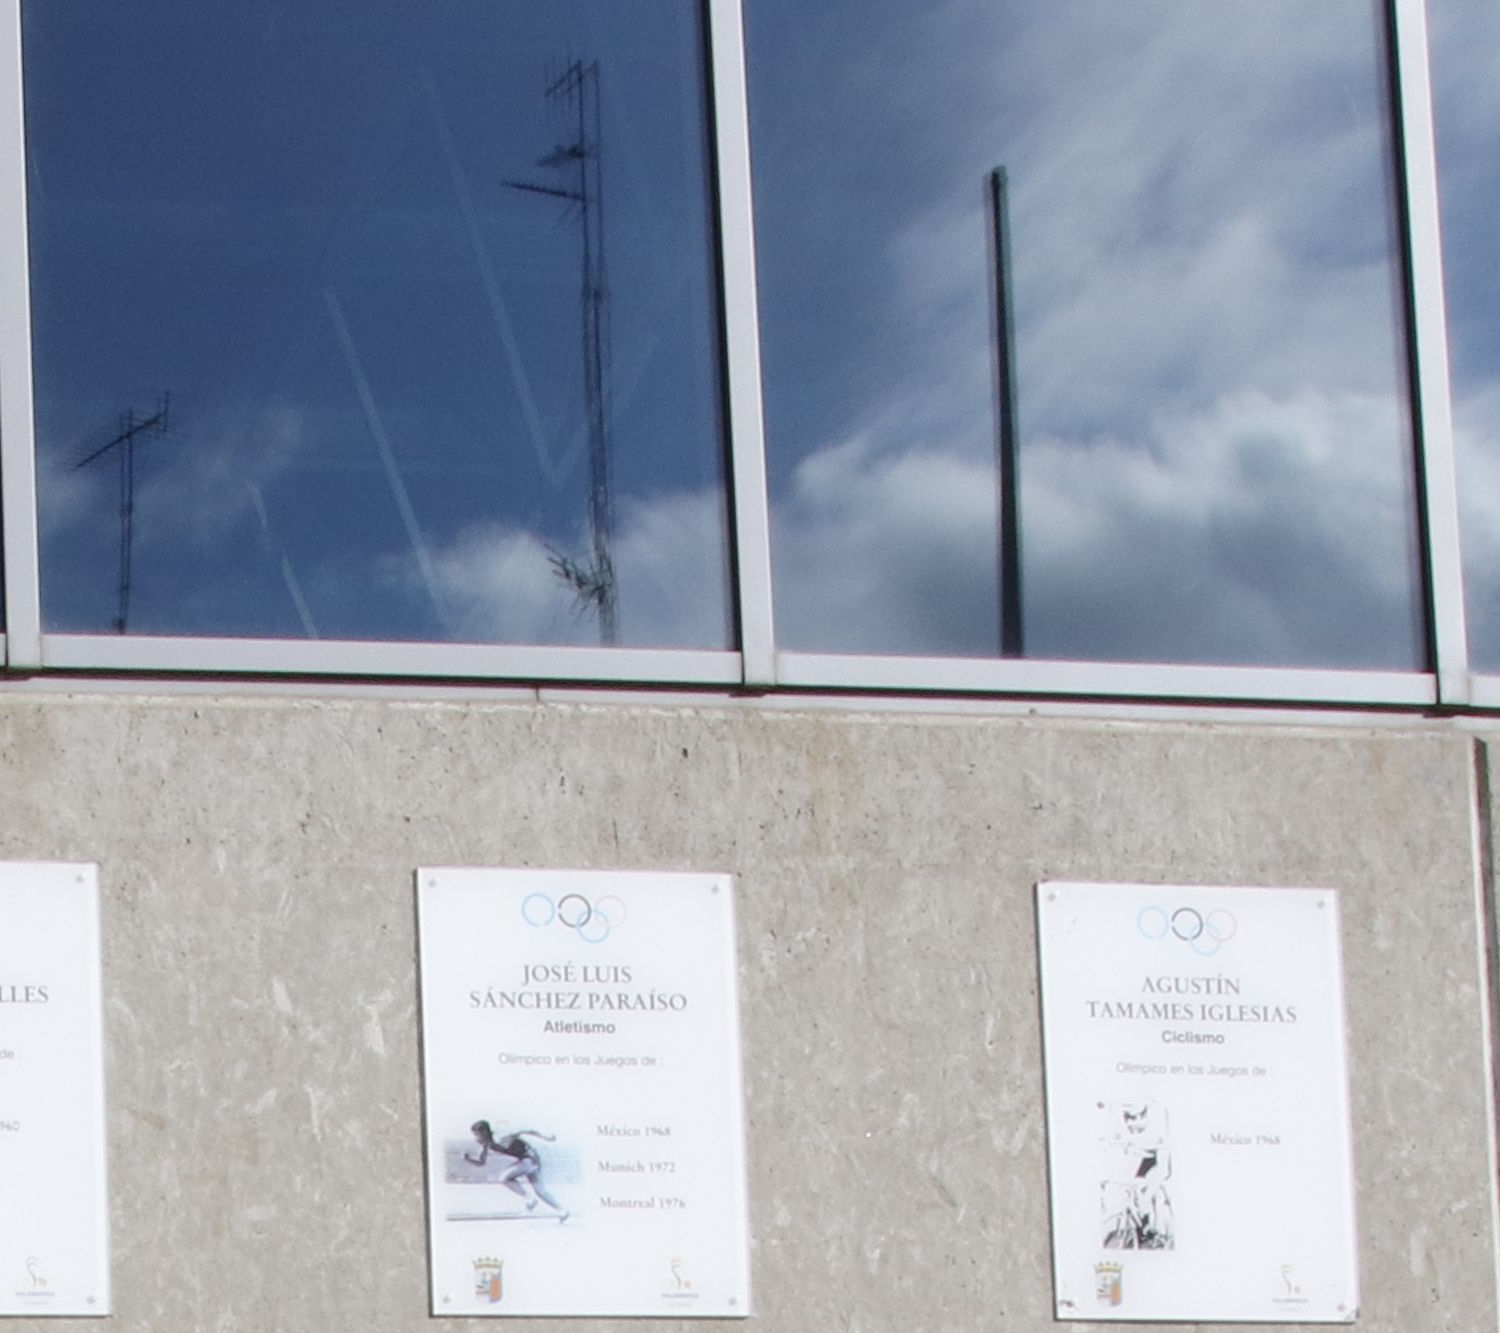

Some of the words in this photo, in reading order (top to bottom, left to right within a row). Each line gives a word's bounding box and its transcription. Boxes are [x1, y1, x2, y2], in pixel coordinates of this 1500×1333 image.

[522, 961, 576, 986] JOSÉ
[583, 966, 632, 983] LUIS
[1142, 974, 1240, 994] AGUSTÍN
[470, 987, 581, 1009] SÁNCHEZ
[588, 989, 687, 1011] PARAÍSO
[1086, 1001, 1194, 1020] TAMAMES
[1200, 1004, 1296, 1022] IGLESIAS
[544, 1020, 616, 1034] Atletismo
[1161, 1030, 1225, 1044] Ciclismo
